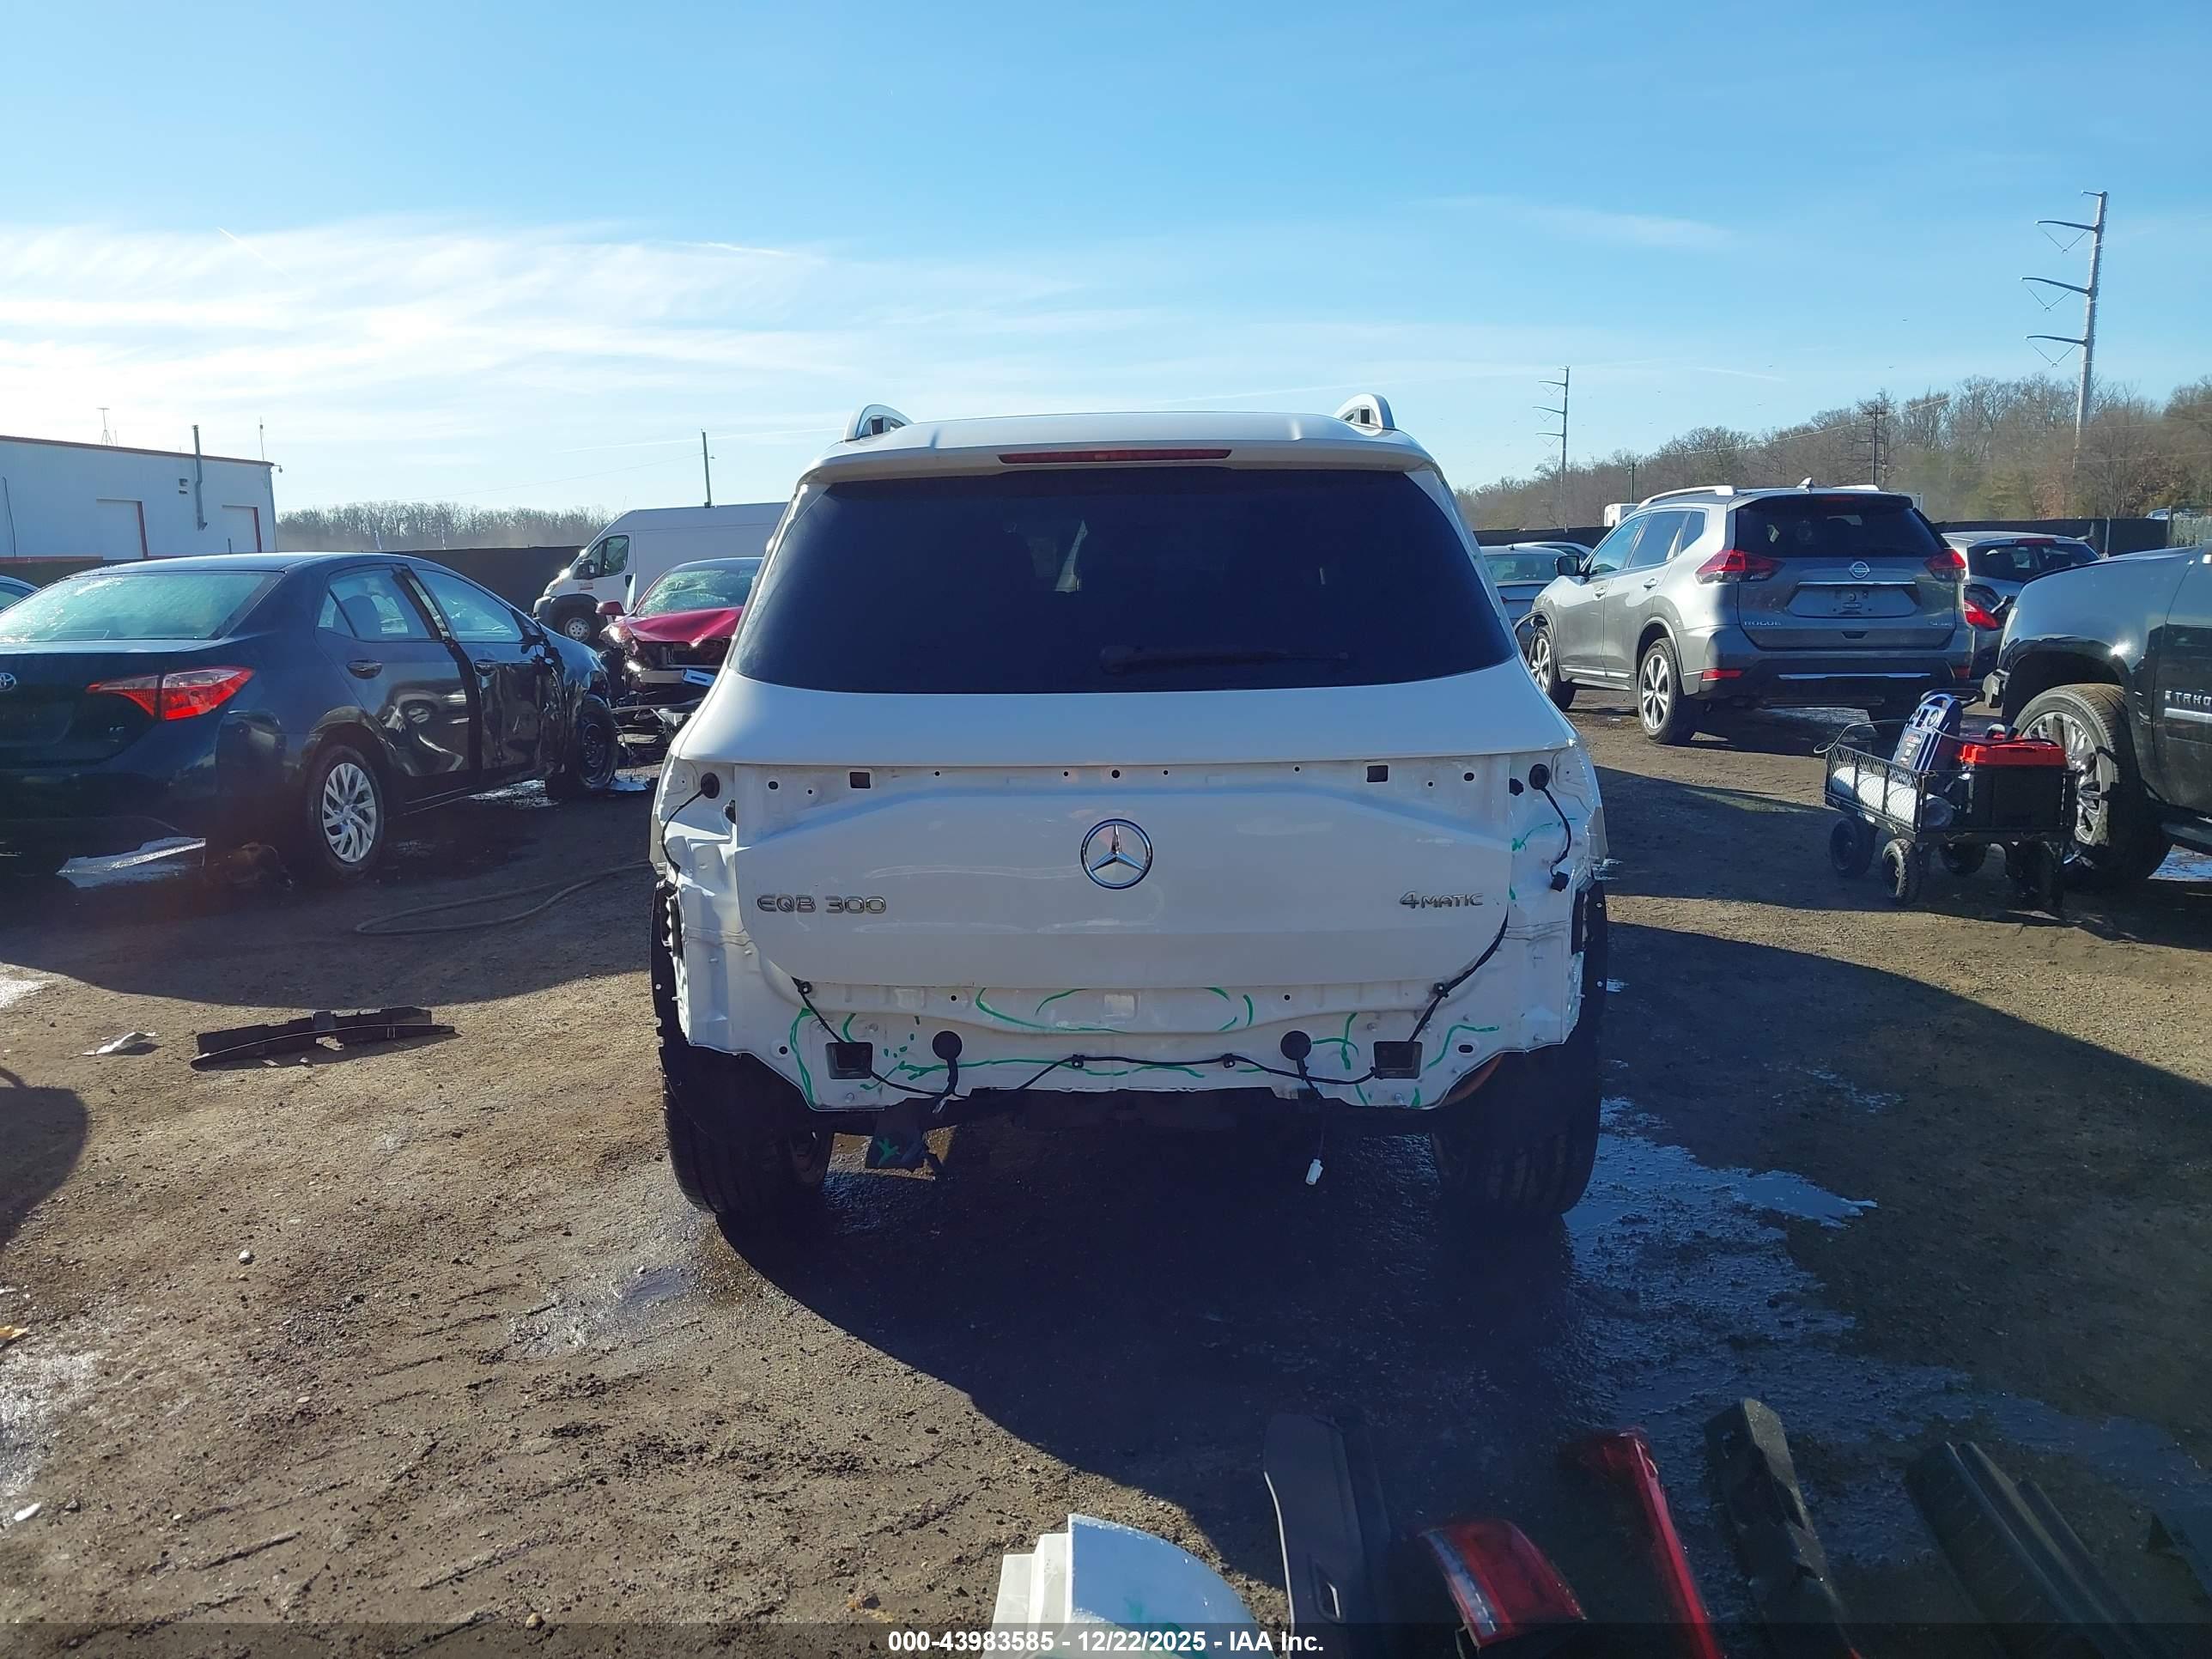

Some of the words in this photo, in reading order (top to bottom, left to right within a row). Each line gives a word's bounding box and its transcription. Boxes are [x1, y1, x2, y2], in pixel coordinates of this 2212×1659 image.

[757, 895, 816, 914] EQB
[824, 896, 887, 915] 300
[1400, 890, 1484, 908] 4MATIC
